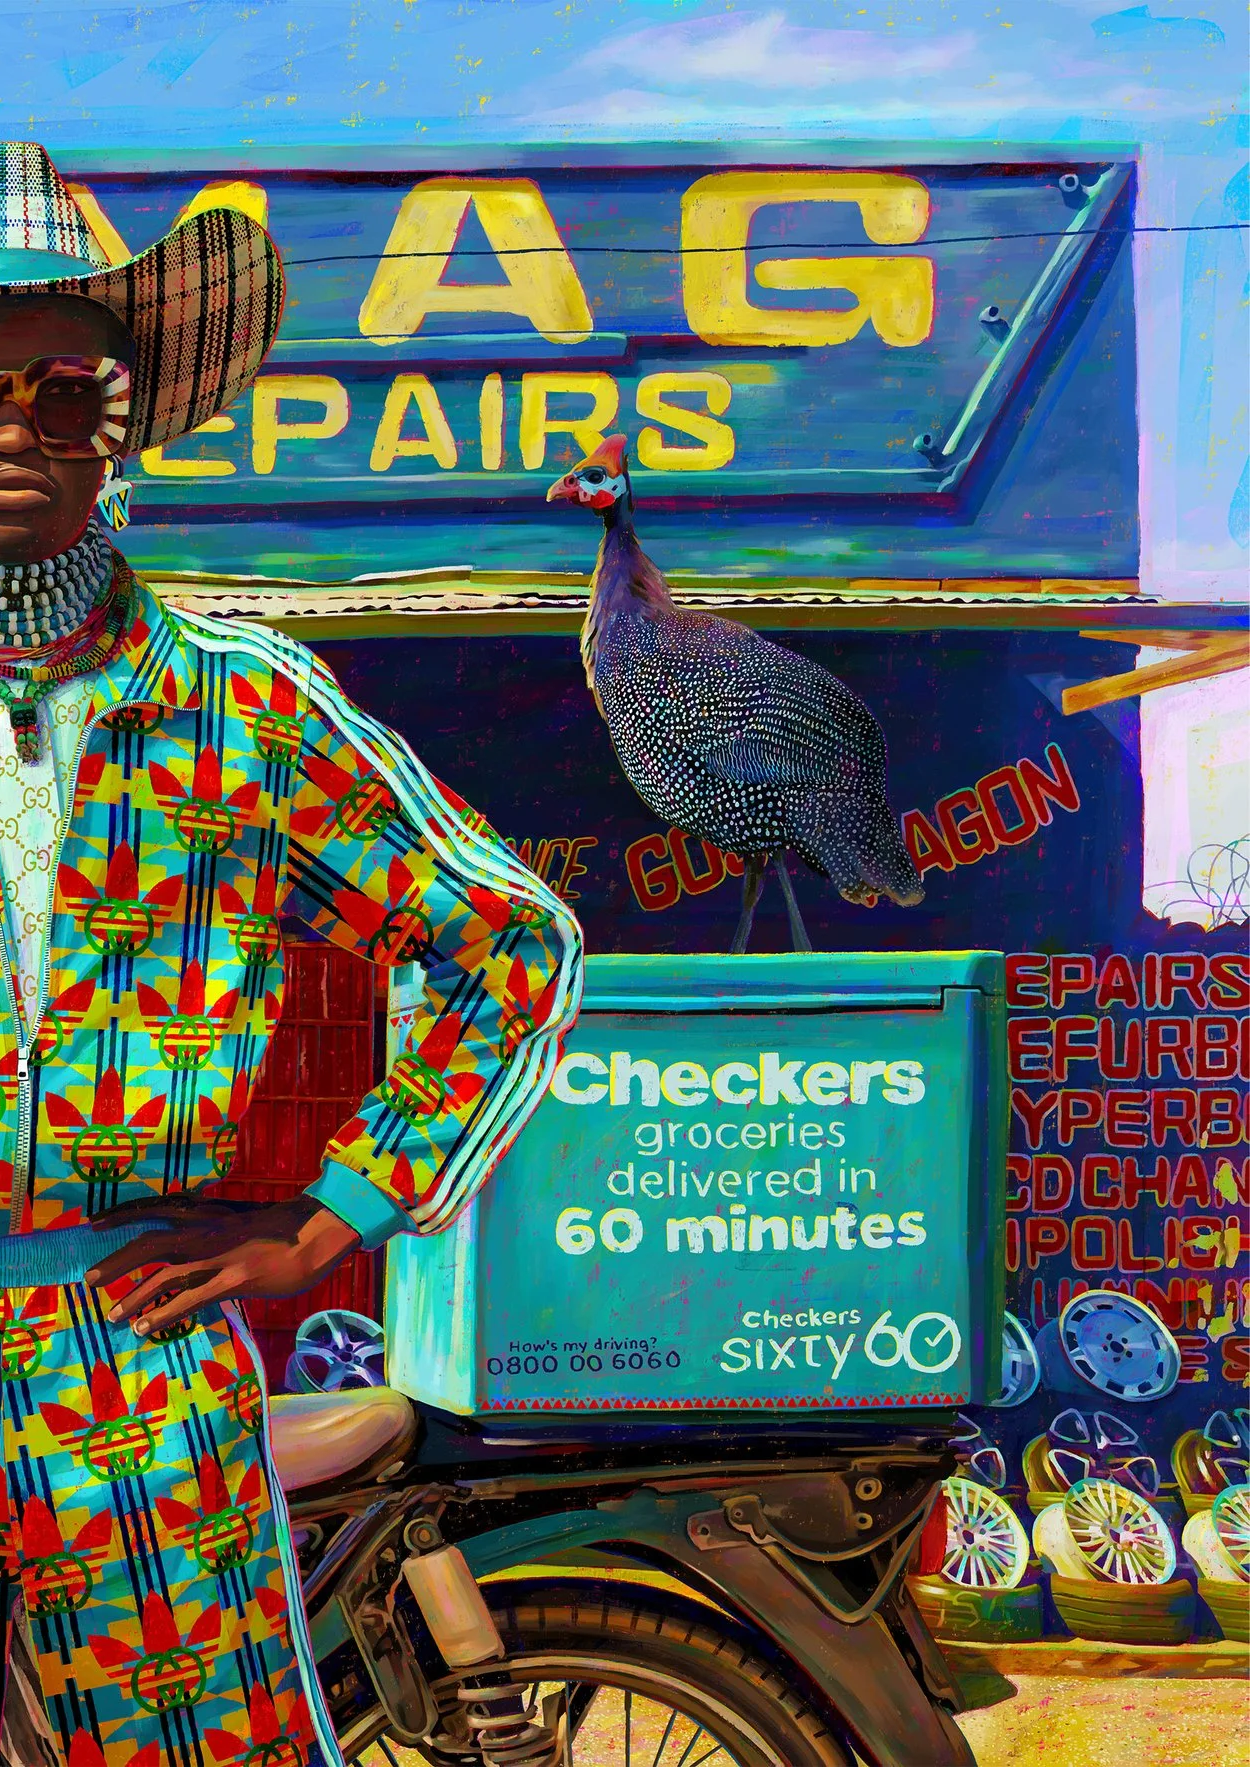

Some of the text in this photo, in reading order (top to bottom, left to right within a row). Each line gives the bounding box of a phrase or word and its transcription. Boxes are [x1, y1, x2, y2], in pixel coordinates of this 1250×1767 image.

[1005, 951, 1250, 1010] EPAIRS
[550, 1051, 926, 1106] Checkers
[635, 1113, 846, 1156] groceries
[1011, 1087, 1250, 1150] YPERB
[606, 1158, 877, 1199] delivered in
[555, 1203, 927, 1255] 60 minutes
[487, 1350, 681, 1375] 0800 00 6060
[509, 1336, 658, 1353] How's my driving?
